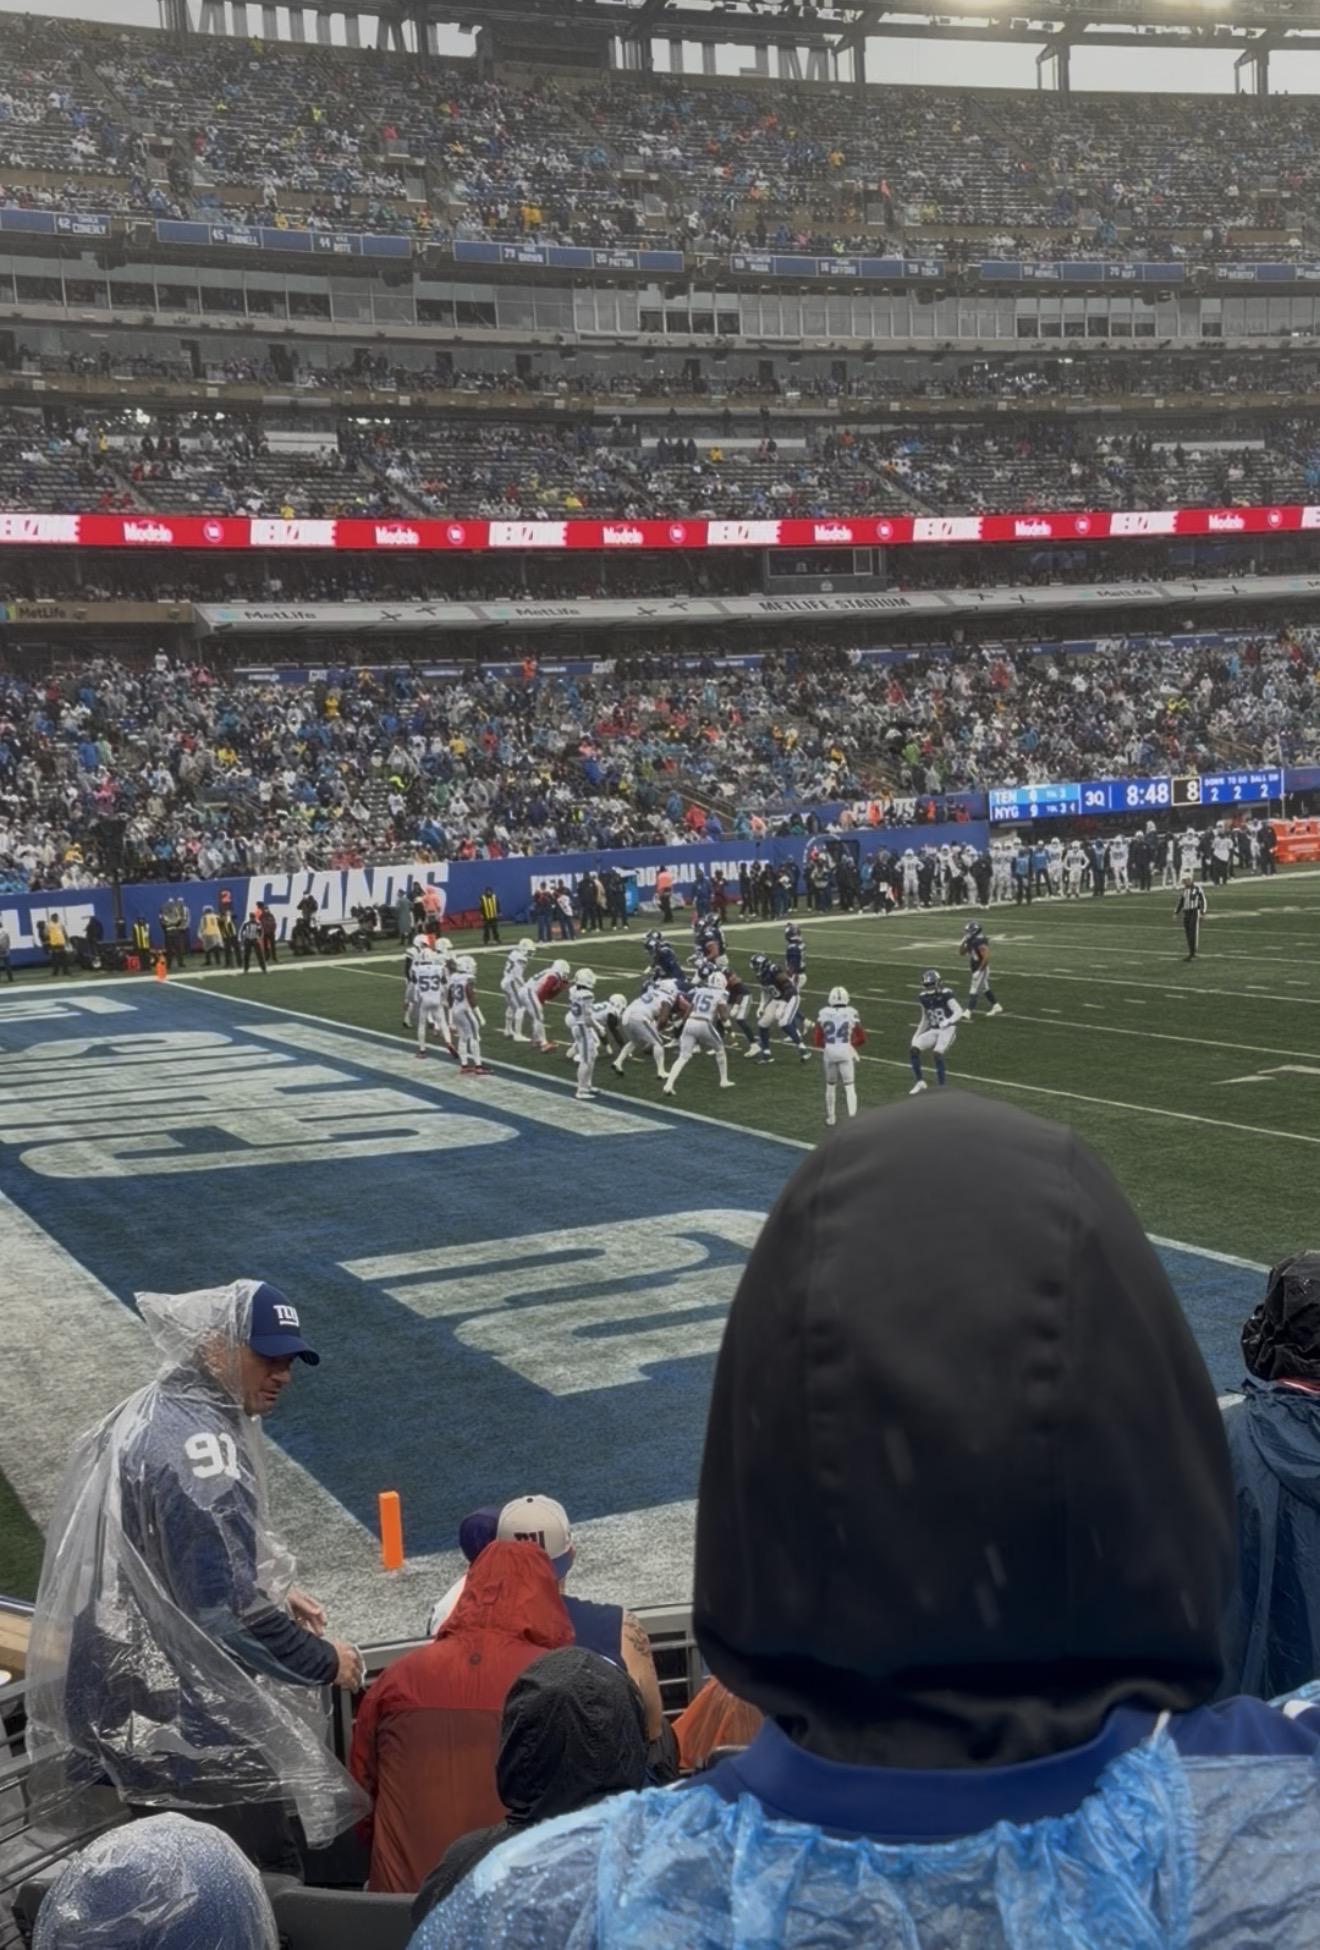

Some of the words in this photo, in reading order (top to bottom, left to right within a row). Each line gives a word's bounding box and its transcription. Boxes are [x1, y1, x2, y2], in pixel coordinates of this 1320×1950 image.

[18, 606, 66, 619] MetLife
[759, 599, 830, 612] METLIFE
[838, 596, 911, 609] STADIUM
[1085, 790, 1105, 807] 3Q
[1126, 782, 1169, 806] 8:48
[1187, 780, 1199, 801] 8
[1210, 787, 1219, 801] 2
[1233, 785, 1242, 800] 2
[1260, 783, 1268, 798] 2
[994, 805, 1020, 819] NYG
[418, 975, 441, 993] 53
[822, 1020, 850, 1044] 24
[184, 1432, 241, 1480] 91
